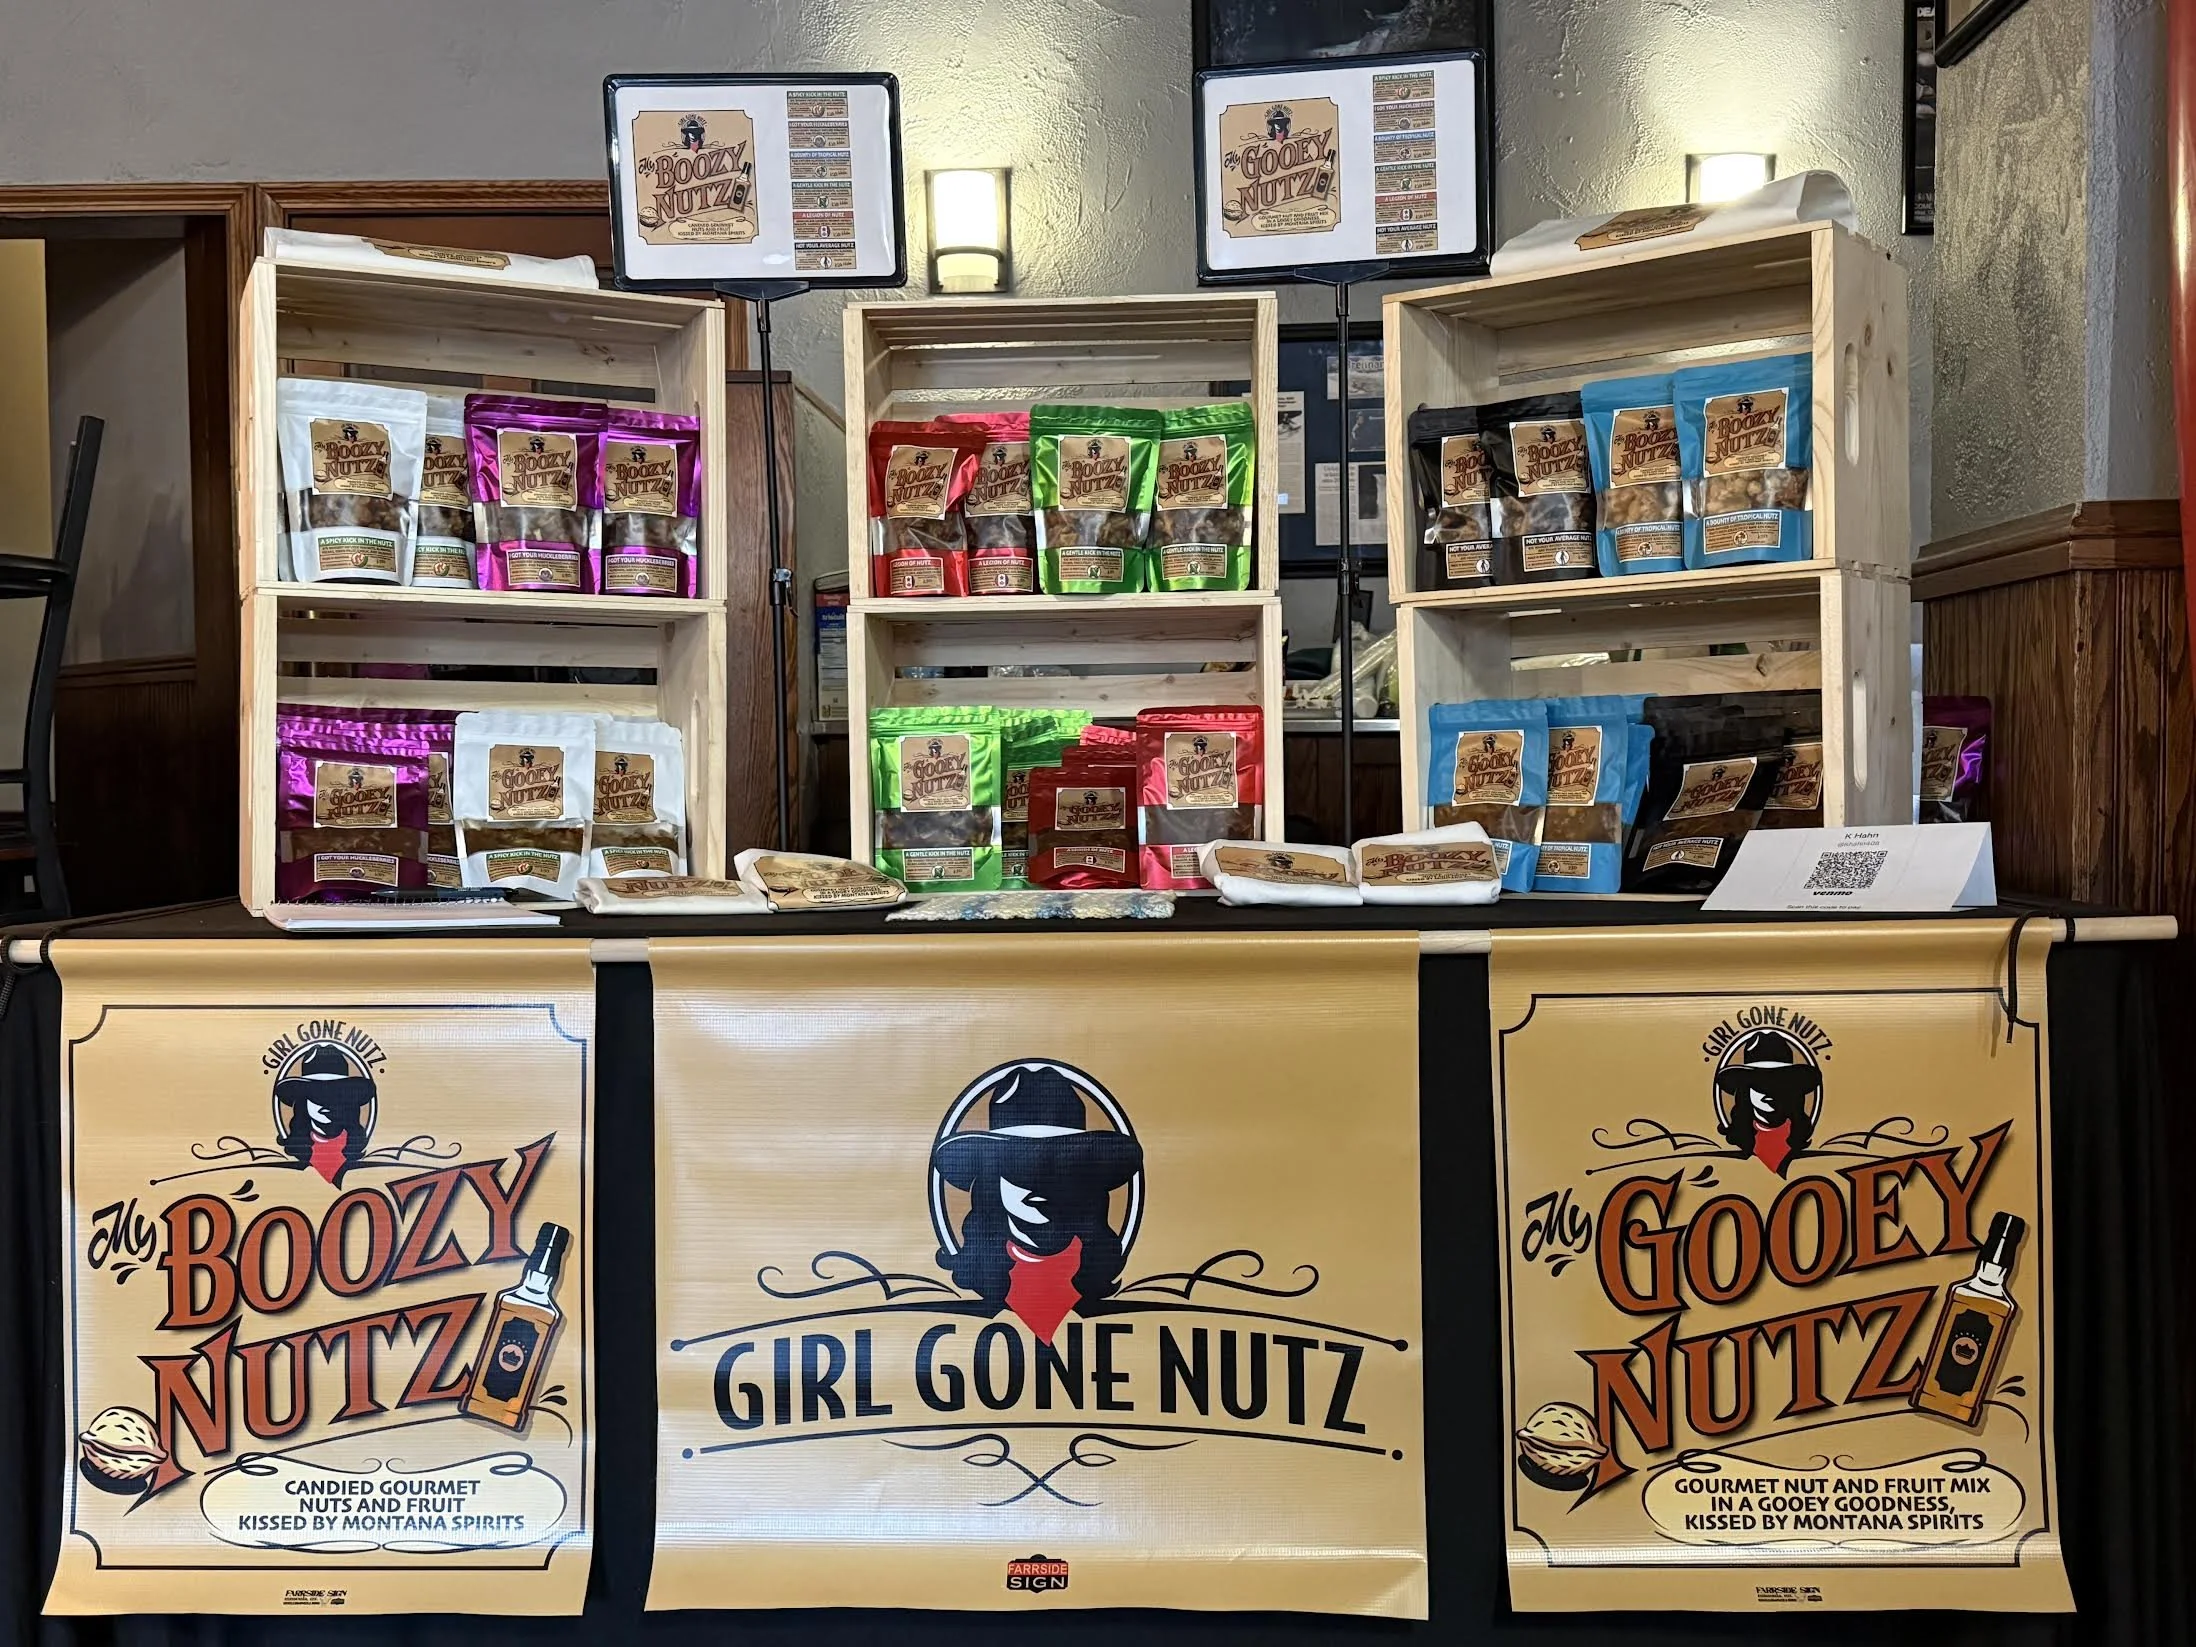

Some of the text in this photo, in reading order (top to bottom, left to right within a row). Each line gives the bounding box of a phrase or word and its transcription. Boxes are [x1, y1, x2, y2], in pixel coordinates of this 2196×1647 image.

[655, 140, 747, 188] BOOZY
[1224, 150, 1240, 168] My
[1241, 127, 1333, 179] GOOEY
[638, 156, 655, 174] My
[651, 178, 733, 231] NUTZ
[1236, 167, 1317, 224] NUTZ
[1718, 406, 1781, 438] BOOZY
[325, 441, 385, 460] BOOZY
[1527, 435, 1582, 462] BOOZY
[1715, 428, 1768, 459] NUTZ
[424, 453, 467, 470] OOZY
[513, 451, 571, 473] BOOZY
[1071, 456, 1124, 479] BOOZY
[1168, 453, 1222, 480] BOOZY
[1526, 454, 1575, 482] NUTZ
[1621, 442, 1674, 473] NUTZ
[324, 458, 378, 481] NUTZ
[615, 460, 671, 480] BOOZY
[896, 463, 947, 486] BOOZY
[978, 461, 1029, 483] BOOZY
[512, 469, 562, 494] NUTZ
[614, 478, 663, 499] NUTZ
[892, 482, 934, 503] NUTZ
[975, 478, 1018, 500] NUTZ
[1069, 475, 1116, 499] NUTZ
[1166, 475, 1212, 498] NUTZ
[913, 752, 966, 778] GOOEY
[1178, 750, 1231, 776] GOOEY
[1468, 748, 1517, 774] GOOEY
[501, 764, 560, 789] GOOEY
[600, 771, 650, 795] GOOEY
[911, 772, 958, 800] NUTZ
[1176, 770, 1220, 796] NUTZ
[1464, 769, 1509, 792] NUTZ
[330, 786, 391, 806] GOOEY
[499, 786, 550, 809] NUTZ
[597, 793, 640, 815] NUTZ
[328, 800, 380, 819] NUTZ
[1385, 851, 1486, 868] BOOZY
[1703, 1006, 1834, 1057] GIRL GONE NUTZ
[264, 1019, 388, 1071] GIRL GONE NUTZ
[1522, 1188, 1592, 1262] My
[1596, 1119, 2014, 1316] GOOEY
[88, 1198, 157, 1269] My
[155, 1131, 558, 1331] BOOZY
[713, 1322, 1367, 1434] GIRL GONE NUTZ
[124, 1293, 488, 1517] NUTZ
[1566, 1285, 1940, 1515] NUTZ
[285, 1480, 481, 1496] CANDIED GOURMET
[1675, 1478, 1991, 1494] GOURMET NUT AND FRUIT MIX
[299, 1498, 465, 1513] NUTS AND FRUIT
[1711, 1496, 1956, 1515] IN A GOOEY GOODNESS,
[238, 1516, 525, 1531] KISSED BY MONTANA SPIRITS
[1685, 1514, 1985, 1530] KISSED BY MONTANA SPIRITS
[1007, 1562, 1068, 1575] FARRSIDE
[1010, 1576, 1066, 1590] SIGN
[1755, 1586, 1821, 1594] FARRSIDE SIGN
